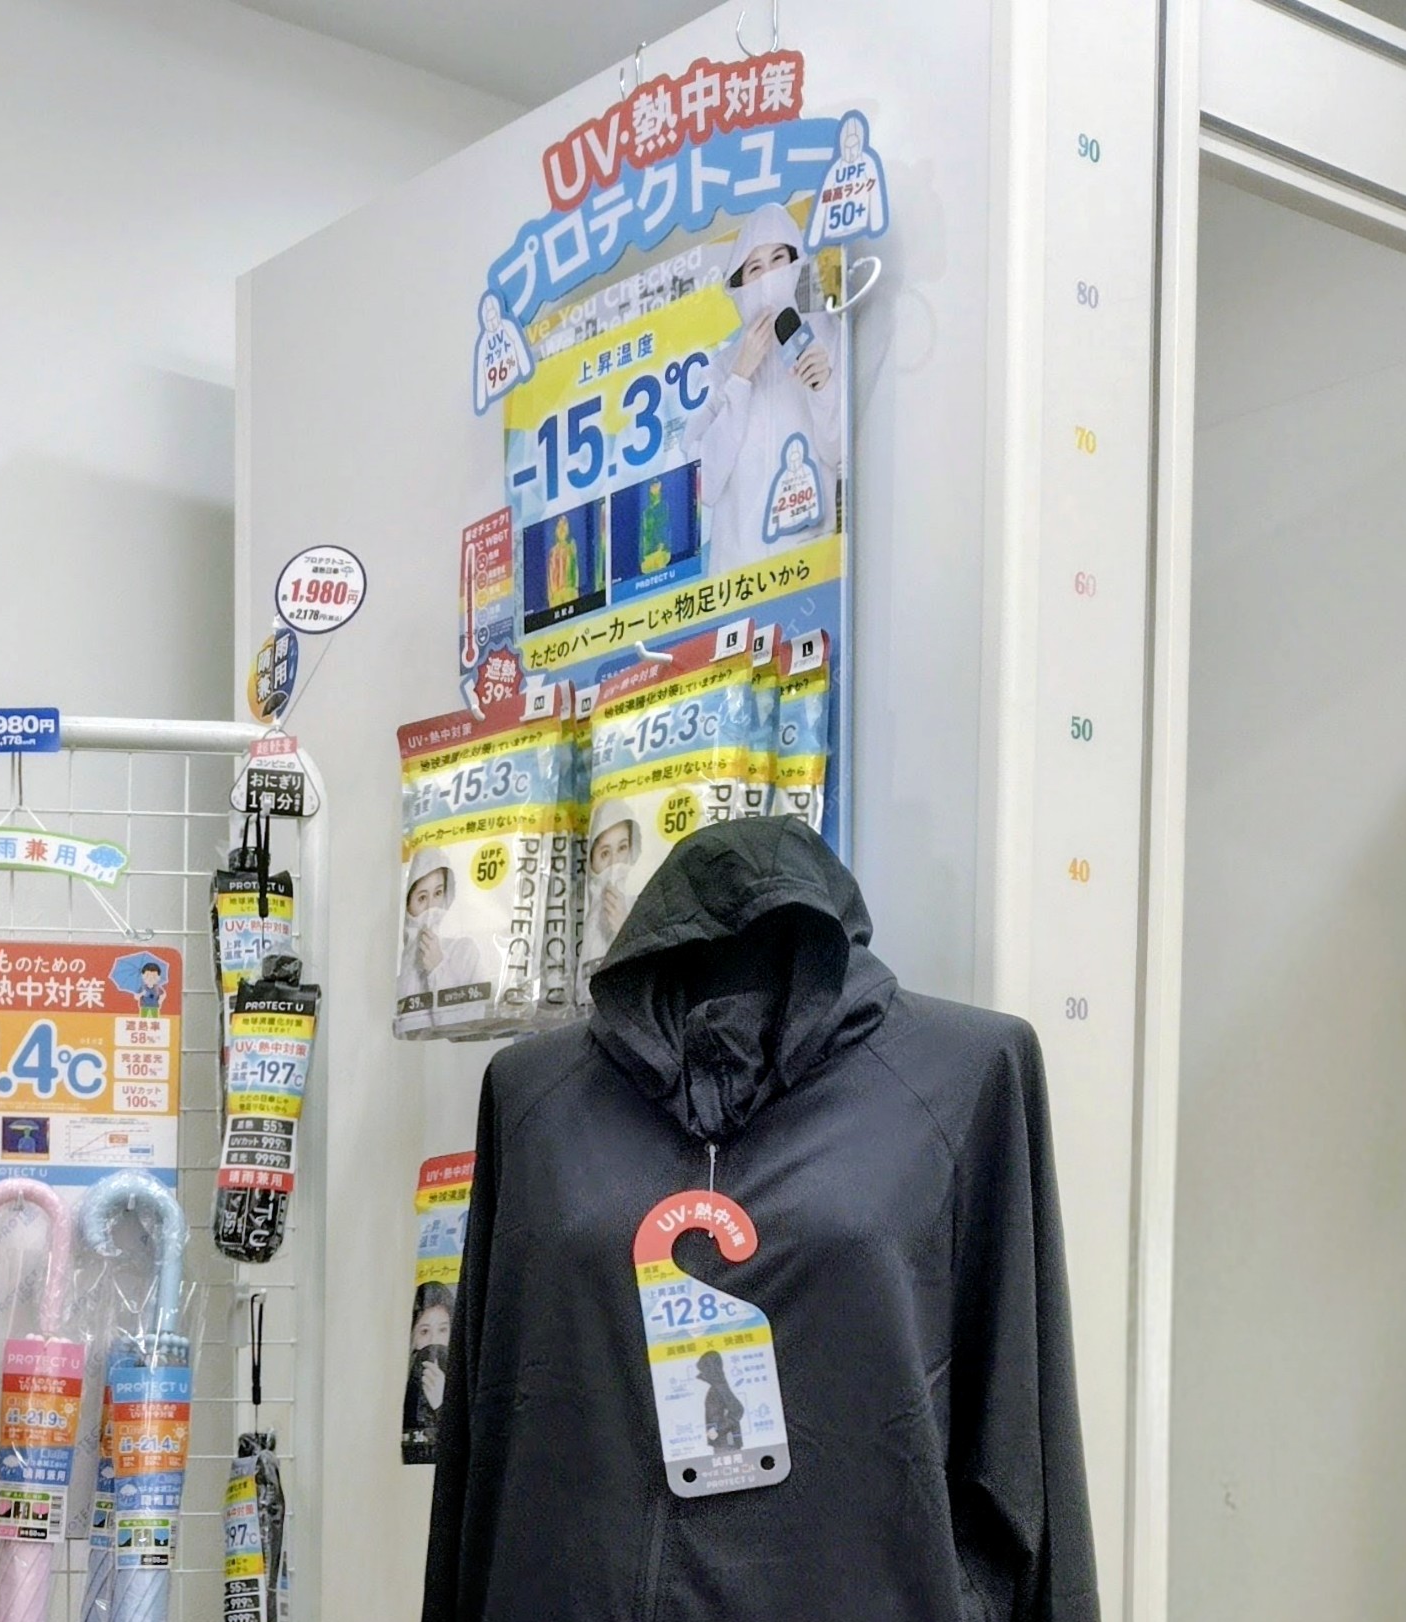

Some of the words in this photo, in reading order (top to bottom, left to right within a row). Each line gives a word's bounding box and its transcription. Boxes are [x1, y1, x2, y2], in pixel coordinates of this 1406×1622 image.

[1078, 133, 1100, 162] 90
[835, 162, 866, 184] UPF
[821, 177, 876, 205] 最高ランク
[499, 131, 833, 315] プロテクトユー
[828, 203, 867, 229] 50+
[559, 300, 594, 328] You
[604, 246, 702, 306] Checked
[1077, 281, 1099, 309] 80
[488, 330, 503, 350] UV
[485, 341, 511, 367] カット
[582, 334, 653, 380] 上昇温度
[488, 355, 515, 388] 96%
[1075, 426, 1096, 453] 70
[635, 573, 668, 590] PROTECT
[1075, 571, 1096, 597] 60
[530, 564, 811, 669] ただのパーカーじゃ物足りないから
[727, 633, 737, 646] L
[754, 637, 763, 650] L
[803, 641, 813, 656] L
[485, 657, 516, 683] 遮熱
[482, 681, 513, 705] 39%
[534, 697, 545, 710] M
[582, 698, 591, 711] M
[1071, 716, 1093, 741] 50
[256, 760, 295, 769] コンビニの
[250, 773, 301, 790] おにぎり
[668, 797, 690, 810] UPF
[664, 808, 695, 833] 50+
[481, 848, 502, 860] UPF
[477, 860, 505, 882] 50+
[1069, 858, 1090, 883] 40
[229, 882, 276, 892] PROTT
[278, 885, 285, 893] U
[508, 838, 539, 976] PROTECT
[245, 1002, 292, 1010] PROTECT
[296, 1003, 304, 1012] U
[1066, 997, 1088, 1020] 30
[126, 1021, 160, 1031] 遮熱率
[122, 1086, 161, 1094] UVカット
[39, 1168, 48, 1177] U
[229, 1170, 283, 1186] 晴雨兼用
[650, 1284, 686, 1297] 上昇温度
[651, 1293, 736, 1328] -12.8℃
[7, 1354, 67, 1368] PROTECT
[71, 1360, 80, 1369] U
[116, 1382, 176, 1393] PROTECT
[180, 1383, 188, 1393] U
